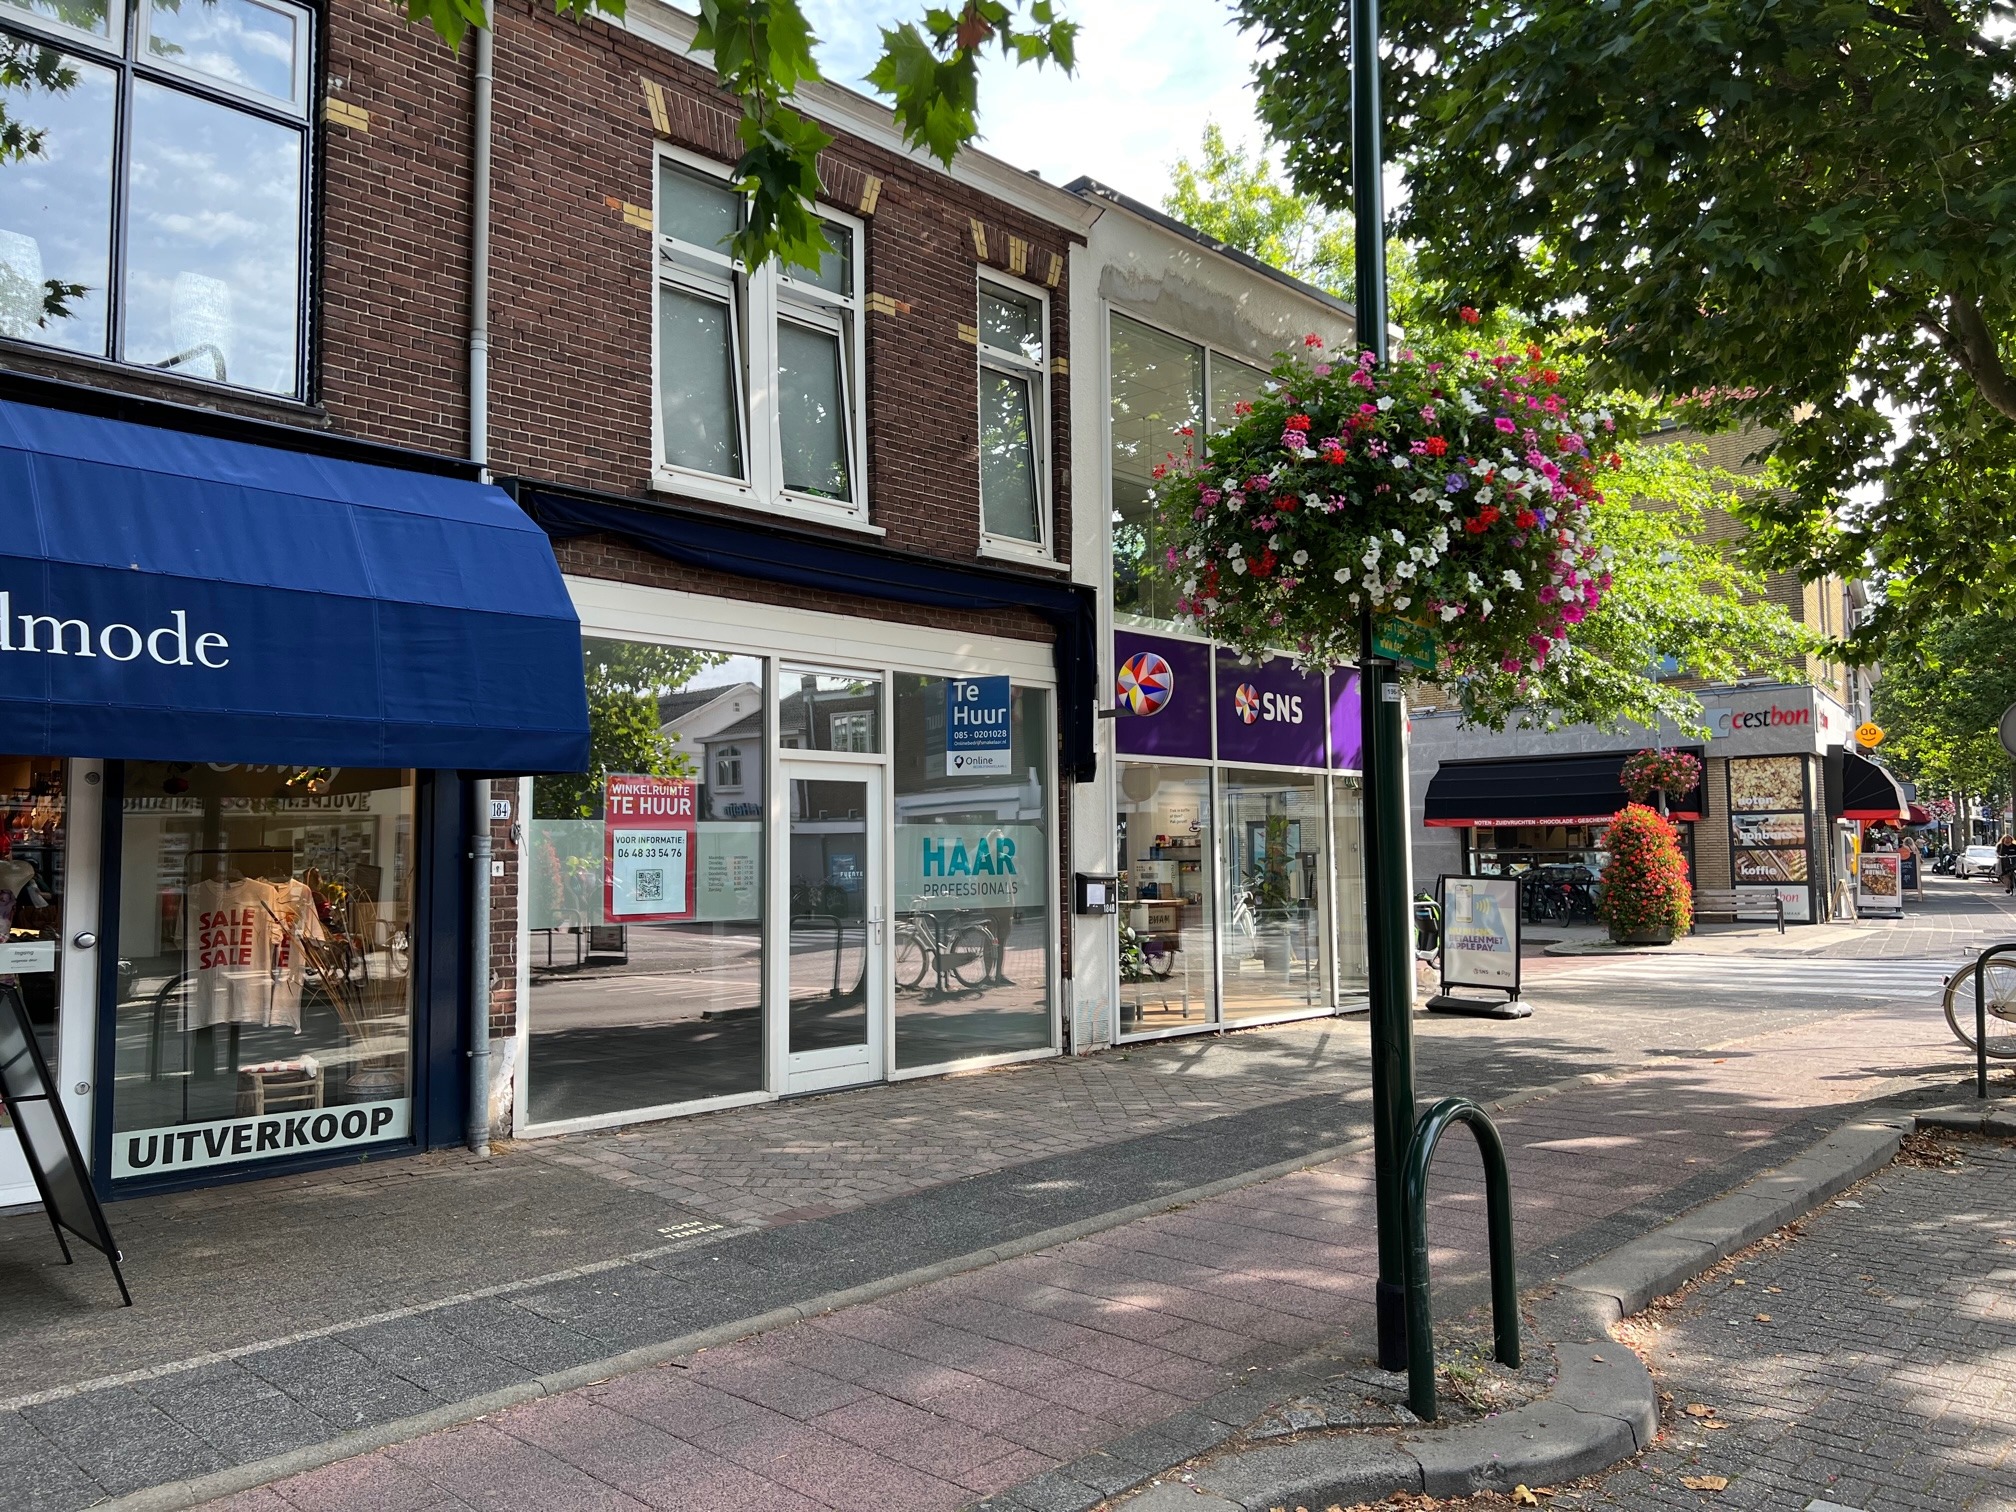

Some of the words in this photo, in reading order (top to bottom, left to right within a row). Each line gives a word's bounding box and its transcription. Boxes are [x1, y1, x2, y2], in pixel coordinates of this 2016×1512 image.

[952, 681, 980, 702] Te
[1262, 691, 1303, 724] SNS
[953, 705, 1007, 726] Huur
[954, 731, 969, 740] 085
[973, 729, 1007, 739] 0201028
[965, 756, 994, 766] Online
[612, 784, 690, 796] WINKELRUIMTE
[492, 802, 507, 817] 184
[610, 796, 634, 814] TE
[639, 796, 691, 816] HUUR
[616, 836, 636, 844] VOOR
[638, 836, 685, 844] INFORMATIE:
[618, 848, 629, 858] 06
[632, 848, 643, 858] 48
[646, 848, 656, 858] 33
[658, 848, 669, 858] 54
[671, 848, 682, 858] 76
[923, 837, 1017, 877] HAAR
[1741, 866, 1777, 875] koffie
[923, 882, 1018, 897] PROFESSIONALS
[199, 909, 255, 931] SALE
[199, 928, 253, 950] SALE
[1449, 935, 1485, 944] BETALEN
[1486, 936, 1504, 945] MET
[1449, 942, 1475, 951] APPLE
[1476, 943, 1496, 952] PAY.
[199, 948, 252, 970] SALE
[127, 1106, 394, 1169] UITVERKOOP
